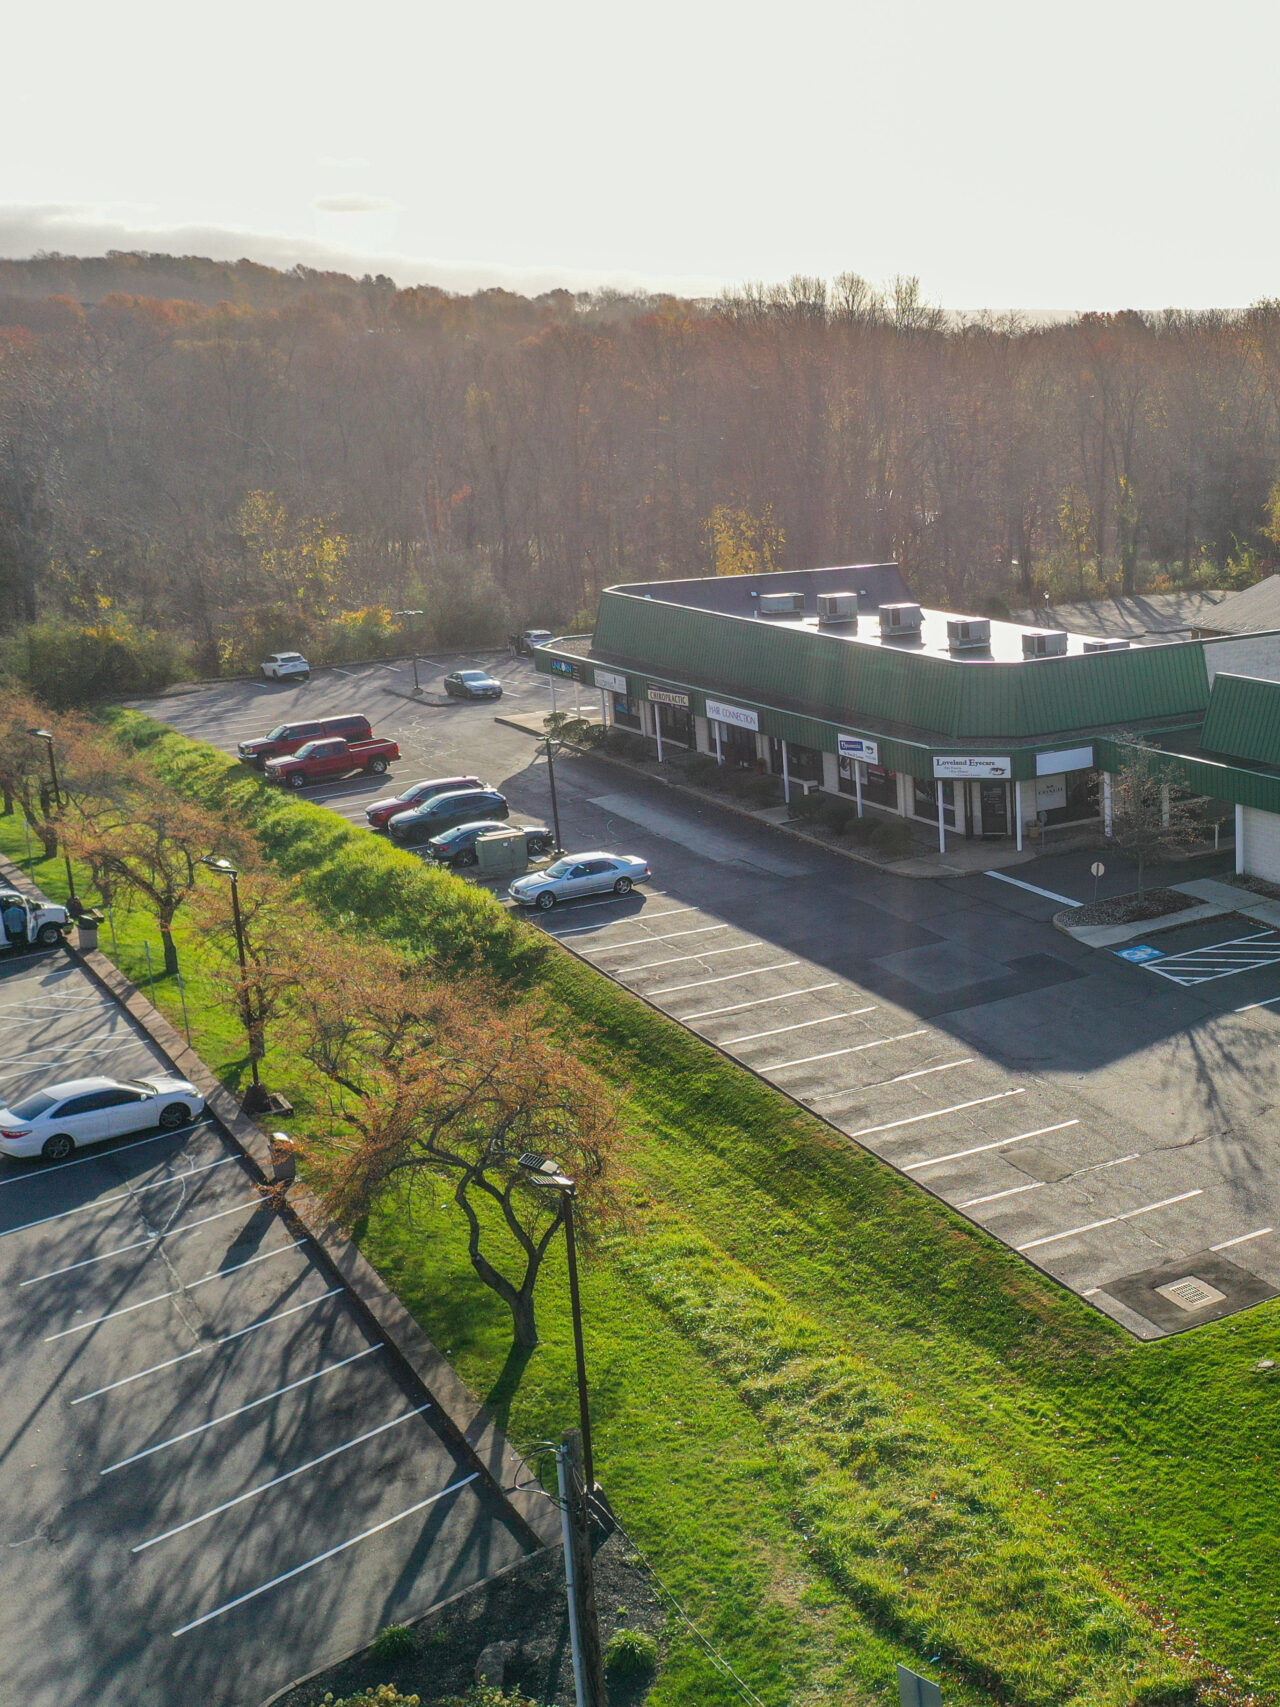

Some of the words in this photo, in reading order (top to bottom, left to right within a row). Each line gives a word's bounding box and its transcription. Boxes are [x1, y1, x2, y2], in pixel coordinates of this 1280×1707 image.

[649, 691, 686, 705] CHIROPRACTIC
[708, 704, 721, 715] HAIR
[722, 708, 756, 725] CONNECTION
[936, 758, 967, 767] Loveland
[968, 758, 995, 767] Eyecare
